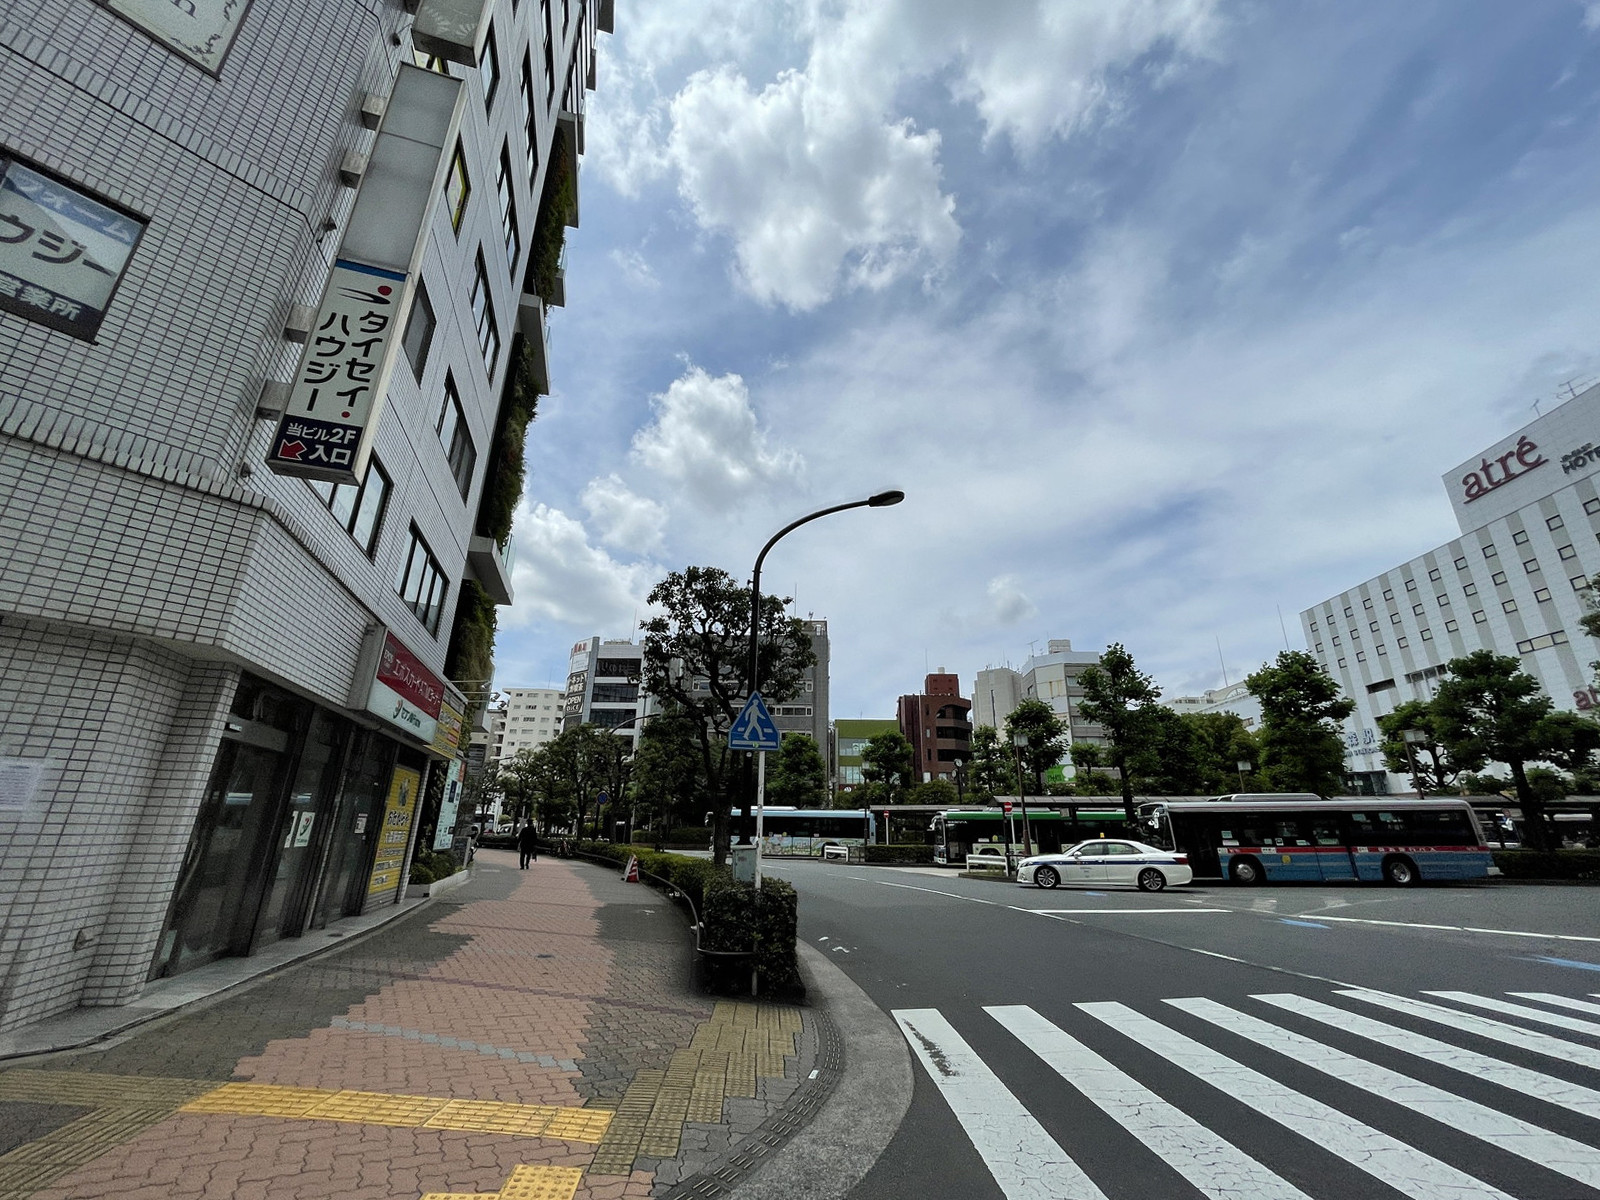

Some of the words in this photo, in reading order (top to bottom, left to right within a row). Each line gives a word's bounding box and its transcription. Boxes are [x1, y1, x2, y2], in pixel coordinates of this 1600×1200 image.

[303, 312, 351, 411] ハウジー
[286, 421, 357, 445] 当ビル2F
[308, 444, 351, 465] 入口
[1461, 435, 1542, 499] atré
